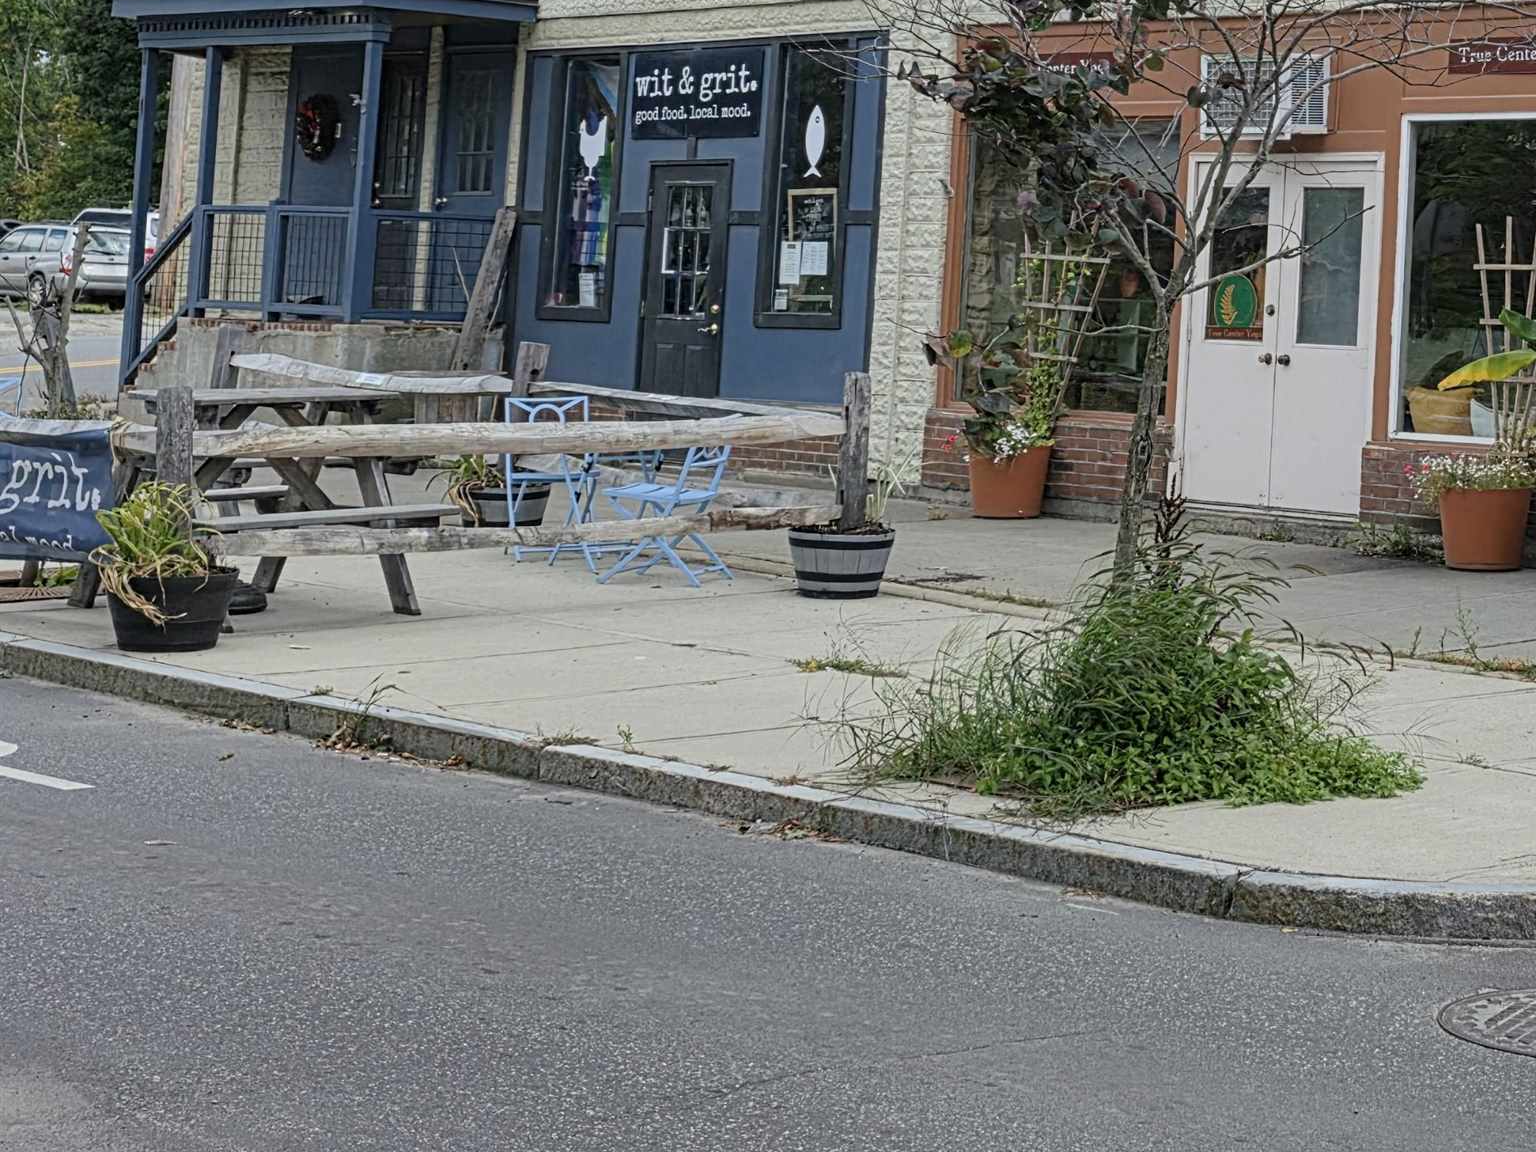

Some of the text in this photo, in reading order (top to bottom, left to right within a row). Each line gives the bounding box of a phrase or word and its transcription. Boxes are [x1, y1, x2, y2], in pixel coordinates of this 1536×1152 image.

[1458, 46, 1492, 64] True
[635, 63, 758, 102] wit & grit.
[635, 102, 751, 125] good food. local mood.
[0, 451, 102, 516] grit.
